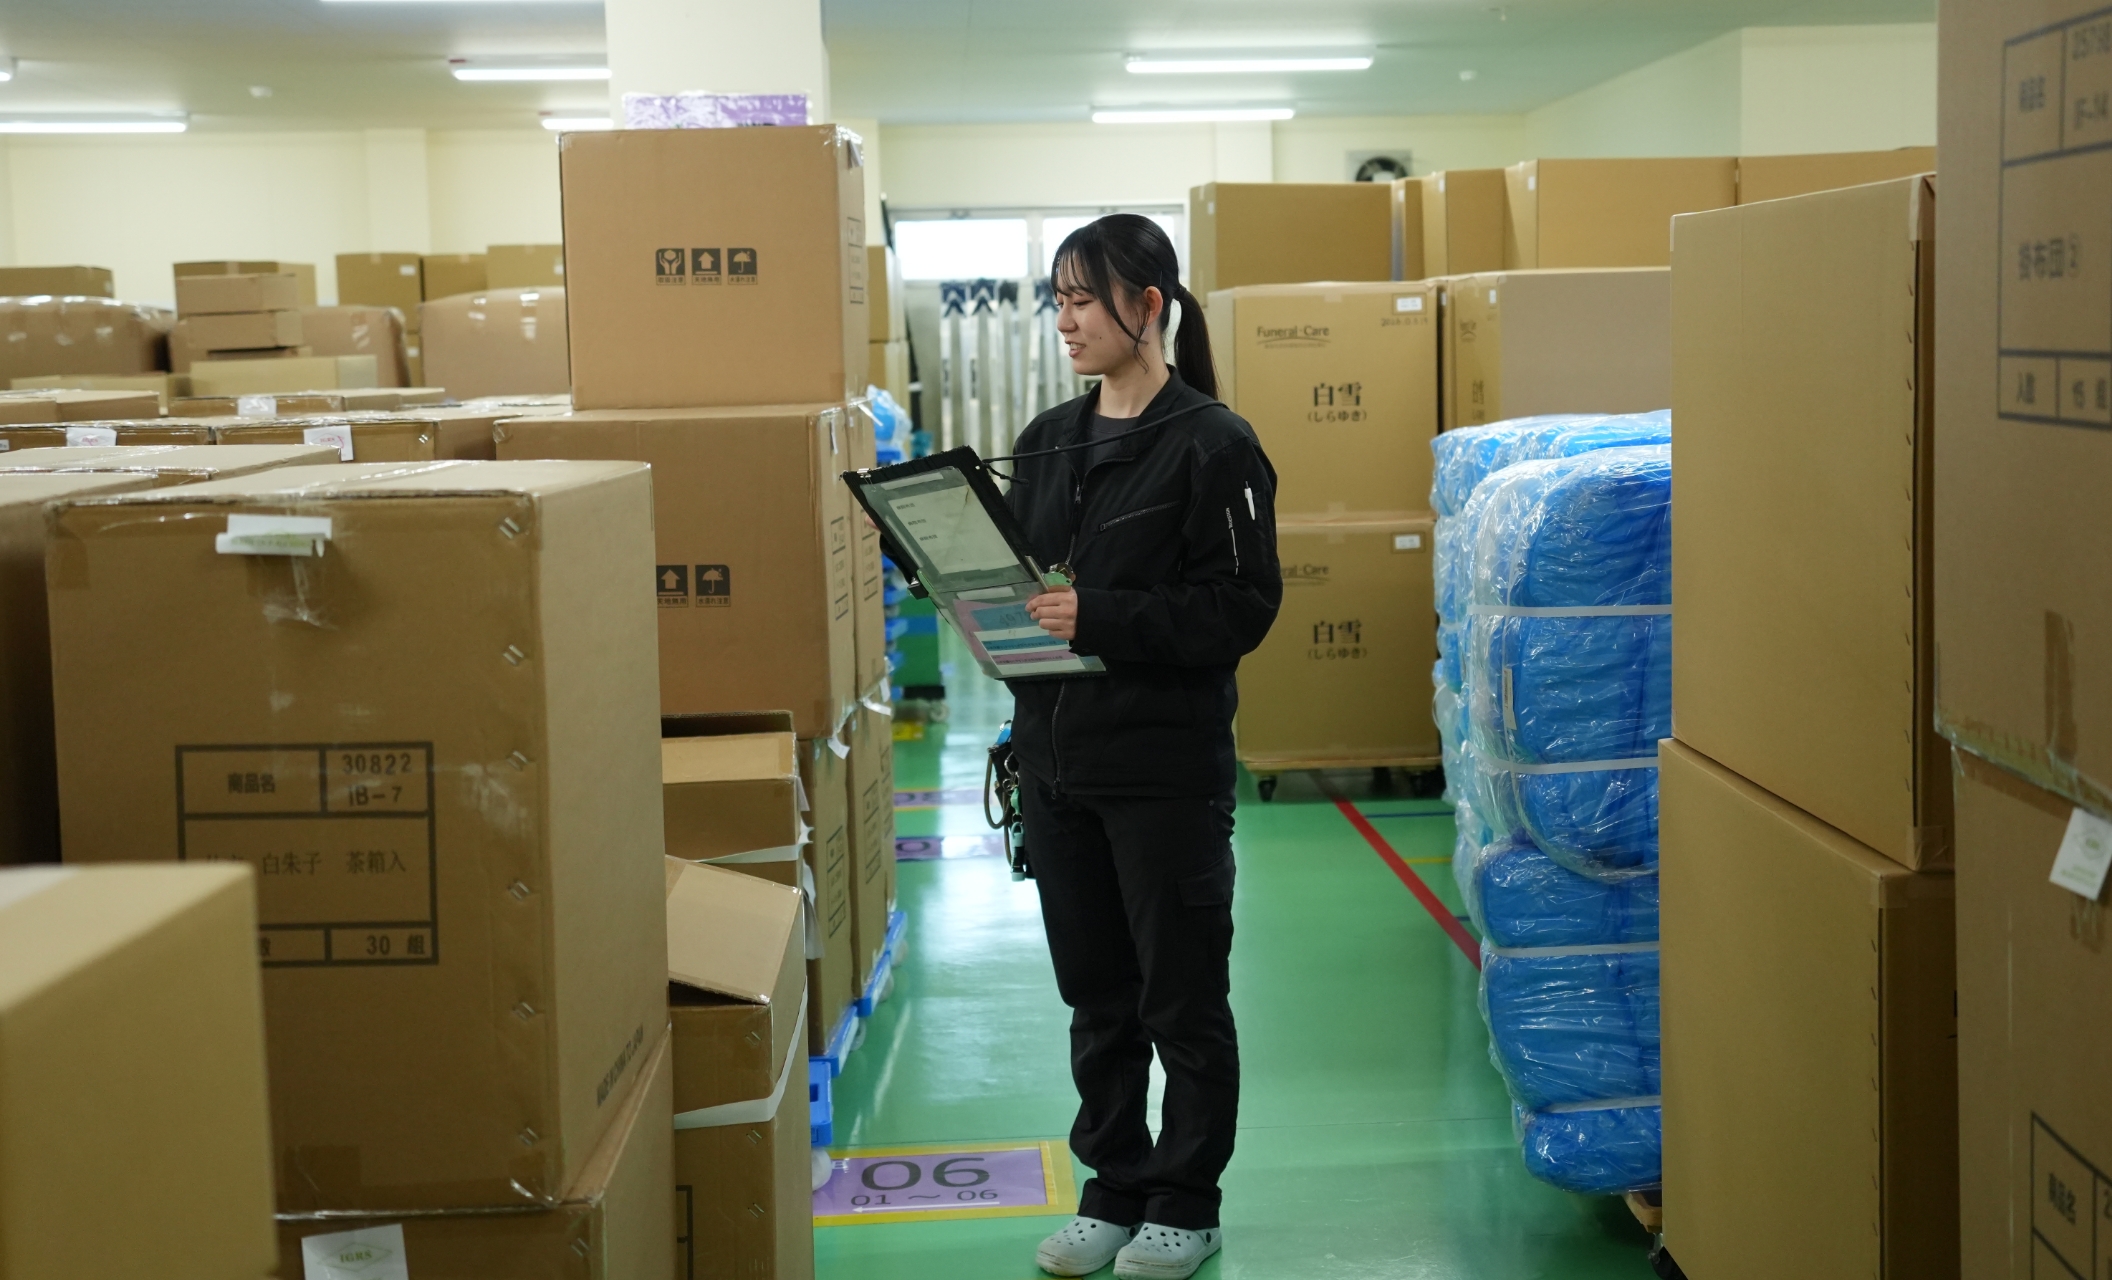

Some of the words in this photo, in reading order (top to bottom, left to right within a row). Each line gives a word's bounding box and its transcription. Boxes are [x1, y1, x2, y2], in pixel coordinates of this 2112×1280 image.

[1313, 382, 1362, 407] 白雪
[1313, 621, 1362, 645] 白雪
[342, 753, 412, 775] 30822
[228, 773, 276, 794] 商品名
[262, 852, 322, 875] 白朱子
[366, 935, 391, 955] 30
[861, 1157, 990, 1191] 06
[850, 1194, 891, 1206] 01
[956, 1189, 999, 1201] 06
